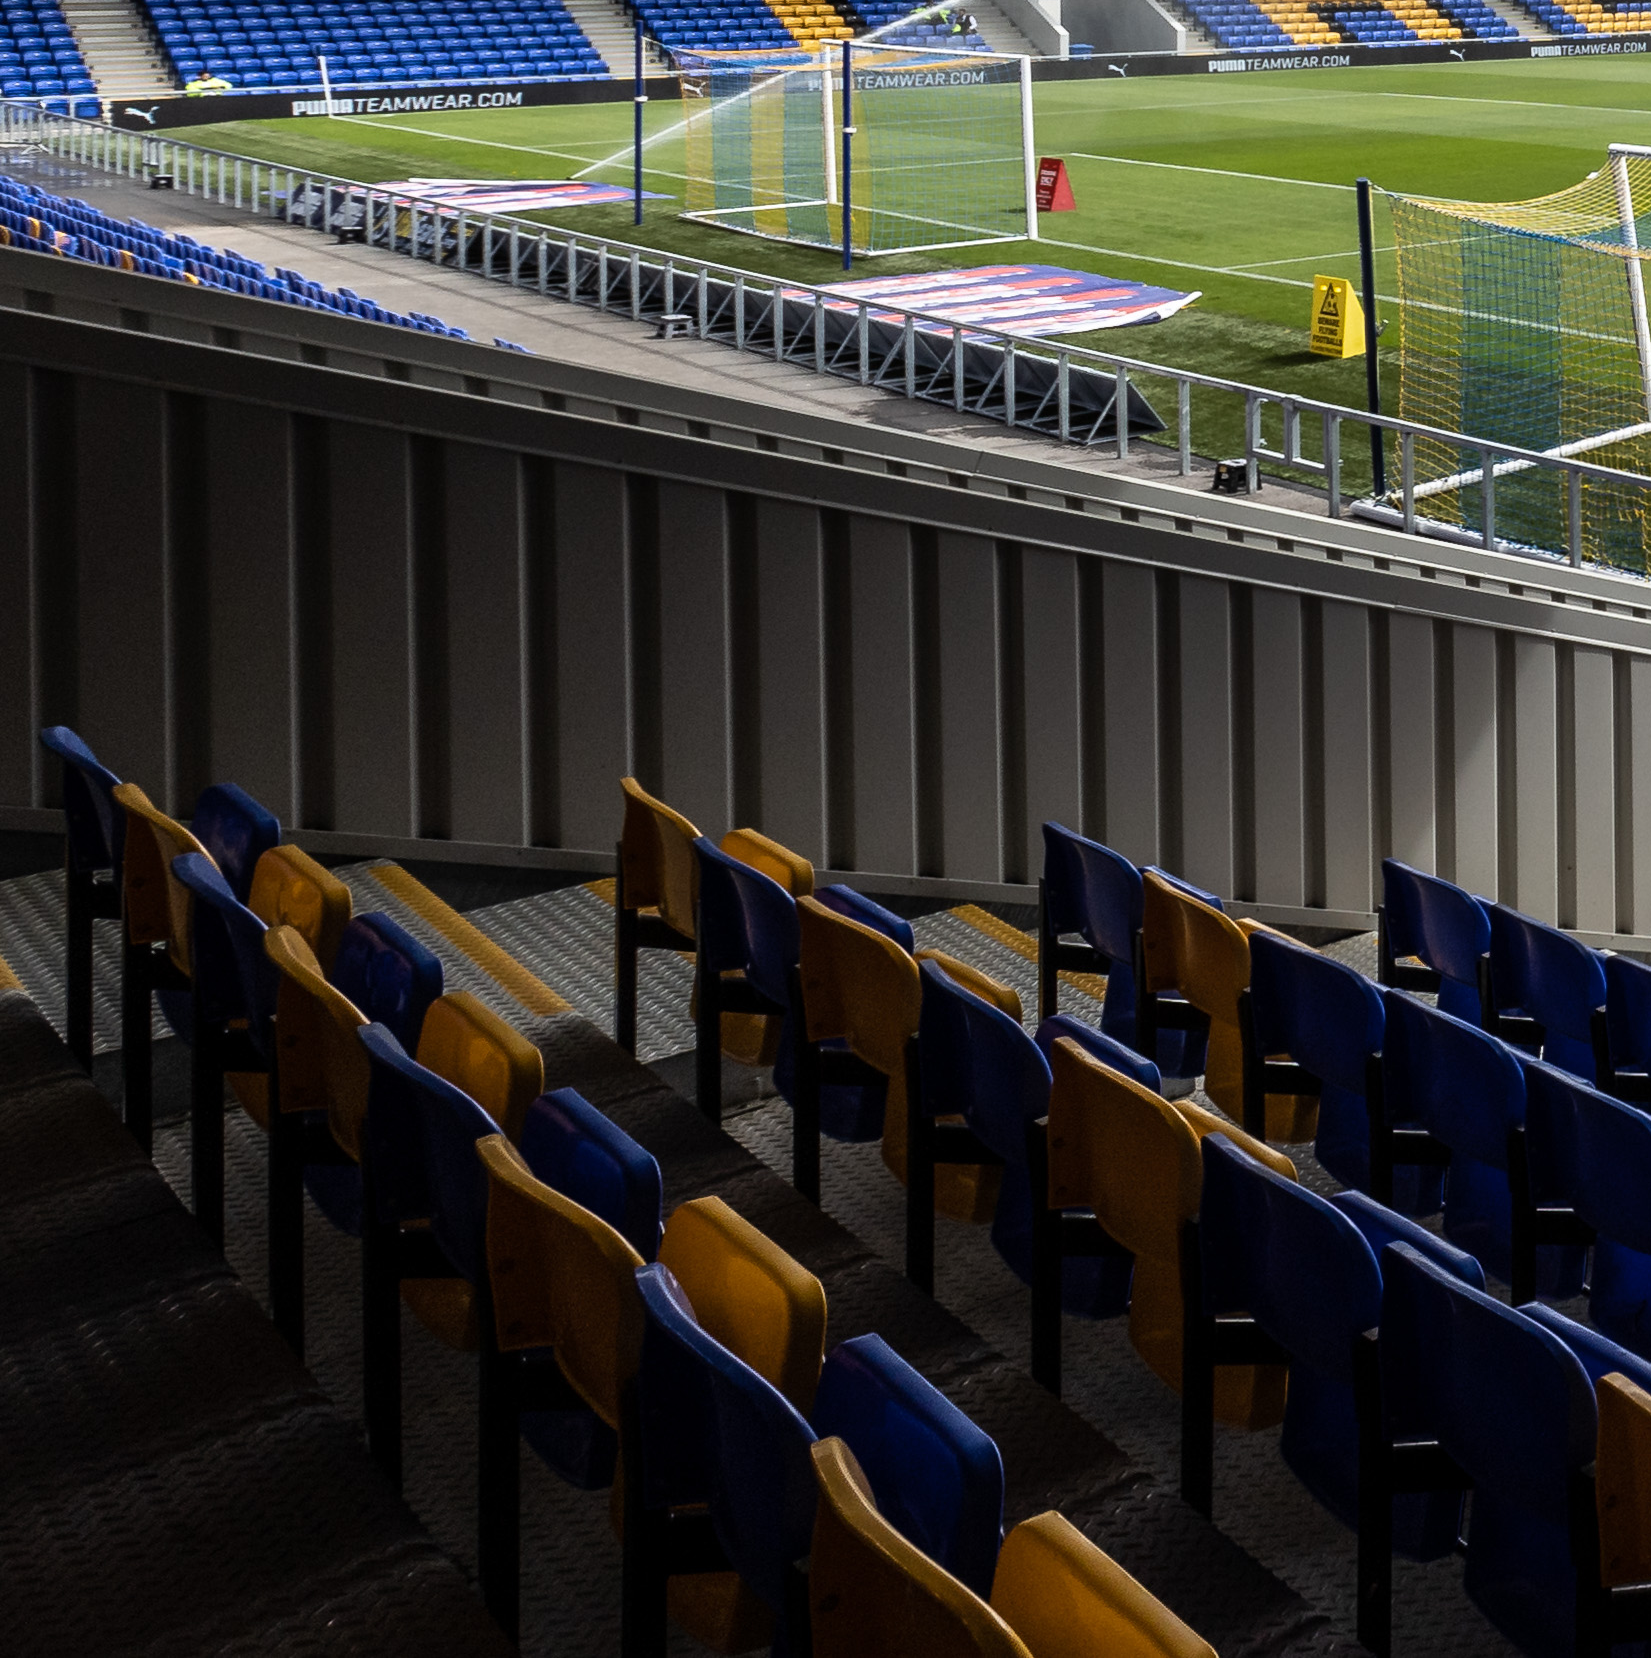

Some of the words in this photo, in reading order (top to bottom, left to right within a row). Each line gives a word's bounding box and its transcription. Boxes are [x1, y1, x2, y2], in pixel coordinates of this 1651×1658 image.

[1530, 42, 1647, 58] PUMATEAMWEAR.COM
[1207, 55, 1351, 74] PUMATEAMWEAR.COM
[807, 71, 985, 92] PMTEAMWEAR.COM
